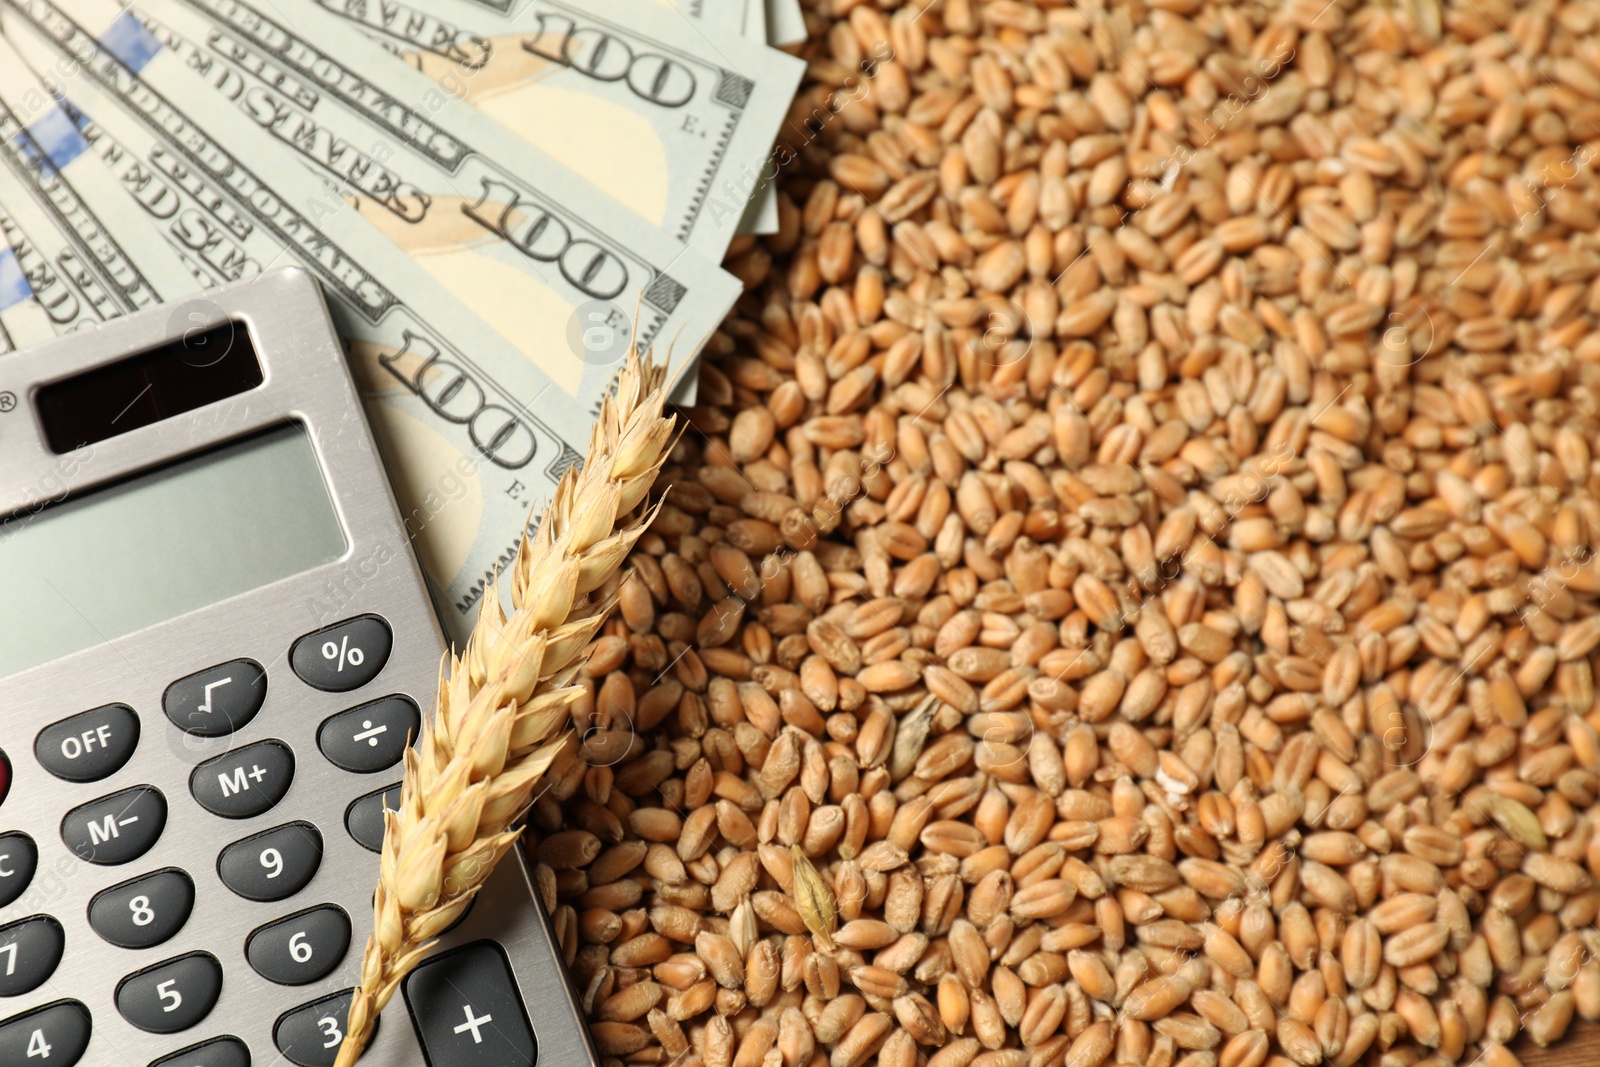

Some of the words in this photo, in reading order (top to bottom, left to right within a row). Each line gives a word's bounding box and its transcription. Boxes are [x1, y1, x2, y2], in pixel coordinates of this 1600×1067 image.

[522, 10, 697, 108] 100
[236, 79, 435, 230] STATES
[222, 163, 393, 312] DOLLARS
[461, 176, 628, 302] 100
[377, 330, 537, 470] 100
[321, 635, 365, 672] %
[61, 724, 113, 760] OFF
[218, 764, 267, 798] M+
[260, 848, 284, 879] 9
[129, 895, 155, 927] 8
[0, 944, 19, 976] 7
[288, 932, 313, 963] 6
[157, 979, 182, 1013] 5
[317, 1016, 344, 1049] 3
[453, 1005, 493, 1045] +
[26, 1029, 52, 1061] 4
